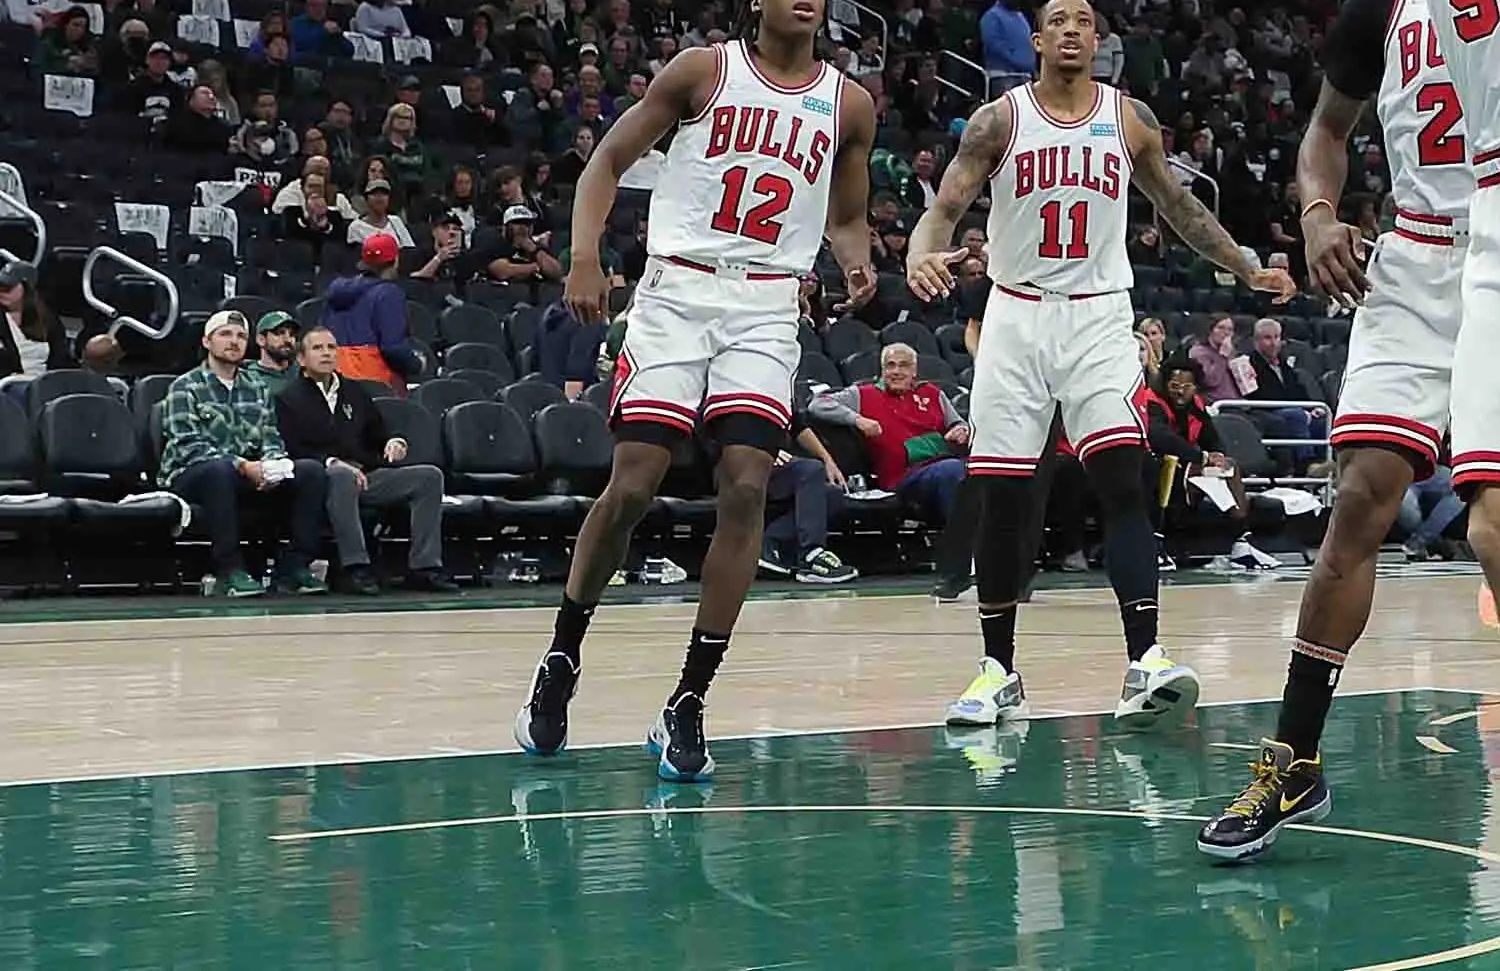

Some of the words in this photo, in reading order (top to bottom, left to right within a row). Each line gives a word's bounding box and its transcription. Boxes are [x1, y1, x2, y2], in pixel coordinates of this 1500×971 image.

[705, 105, 831, 185] BULLS
[1015, 146, 1121, 200] BULLS
[711, 165, 794, 245] 12
[1039, 200, 1089, 259] 11
